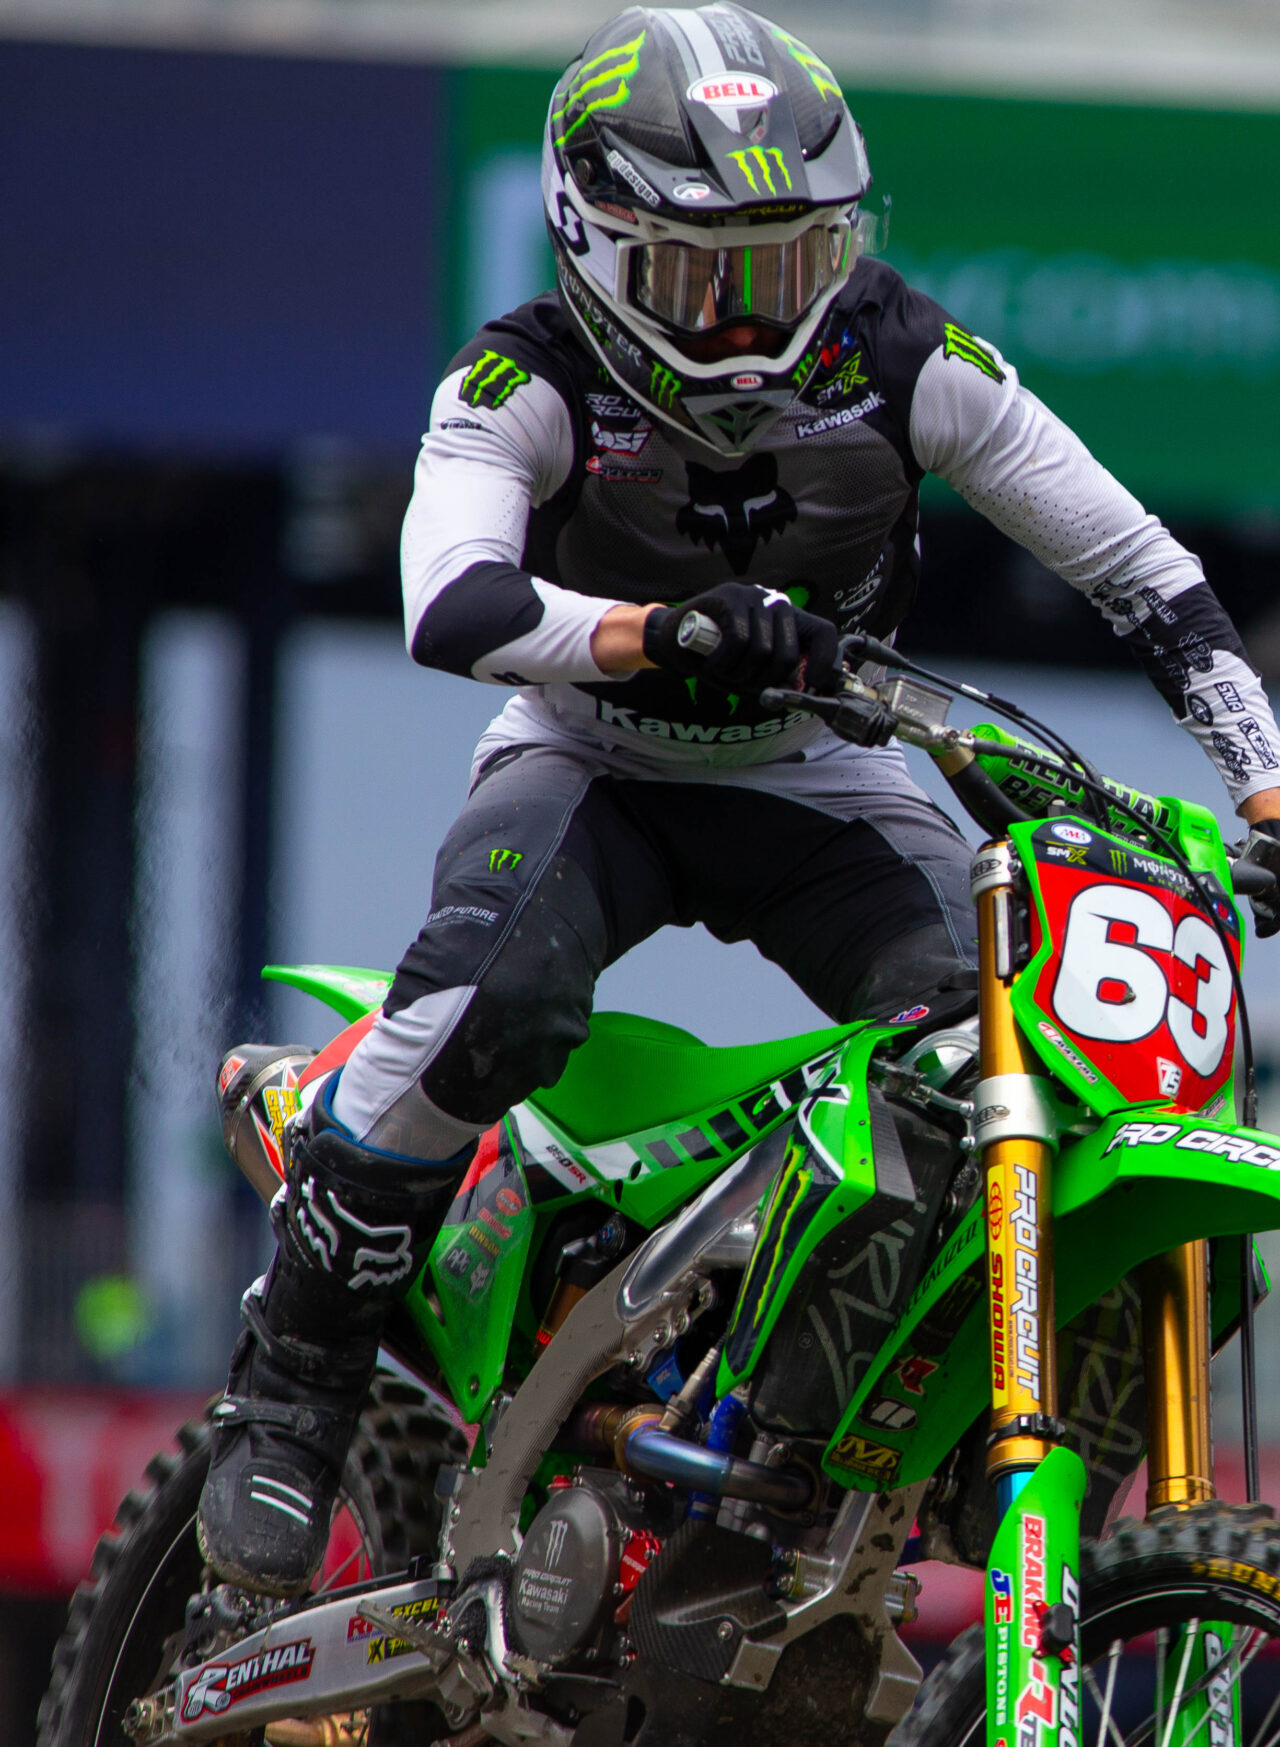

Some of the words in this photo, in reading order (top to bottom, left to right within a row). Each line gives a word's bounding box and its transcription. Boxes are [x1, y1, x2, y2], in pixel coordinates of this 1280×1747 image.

[703, 82, 765, 100] BELL
[736, 377, 759, 385] BELL
[797, 391, 886, 438] Kawasak
[600, 700, 813, 743] Kawasa
[1046, 846, 1089, 866] SMX
[1133, 857, 1198, 896] MONSTE
[1052, 882, 1234, 1078] 63
[1105, 1122, 1182, 1159] PRO
[1011, 1164, 1038, 1250] PRO
[991, 1251, 1005, 1391] SHOWA
[1011, 1248, 1040, 1401] CIRCUIT
[519, 1577, 568, 1604] Kawasaki
[991, 1569, 1011, 1624] JE
[184, 1640, 311, 1719] RENTHAL
[995, 1626, 1009, 1726] PISTONS
